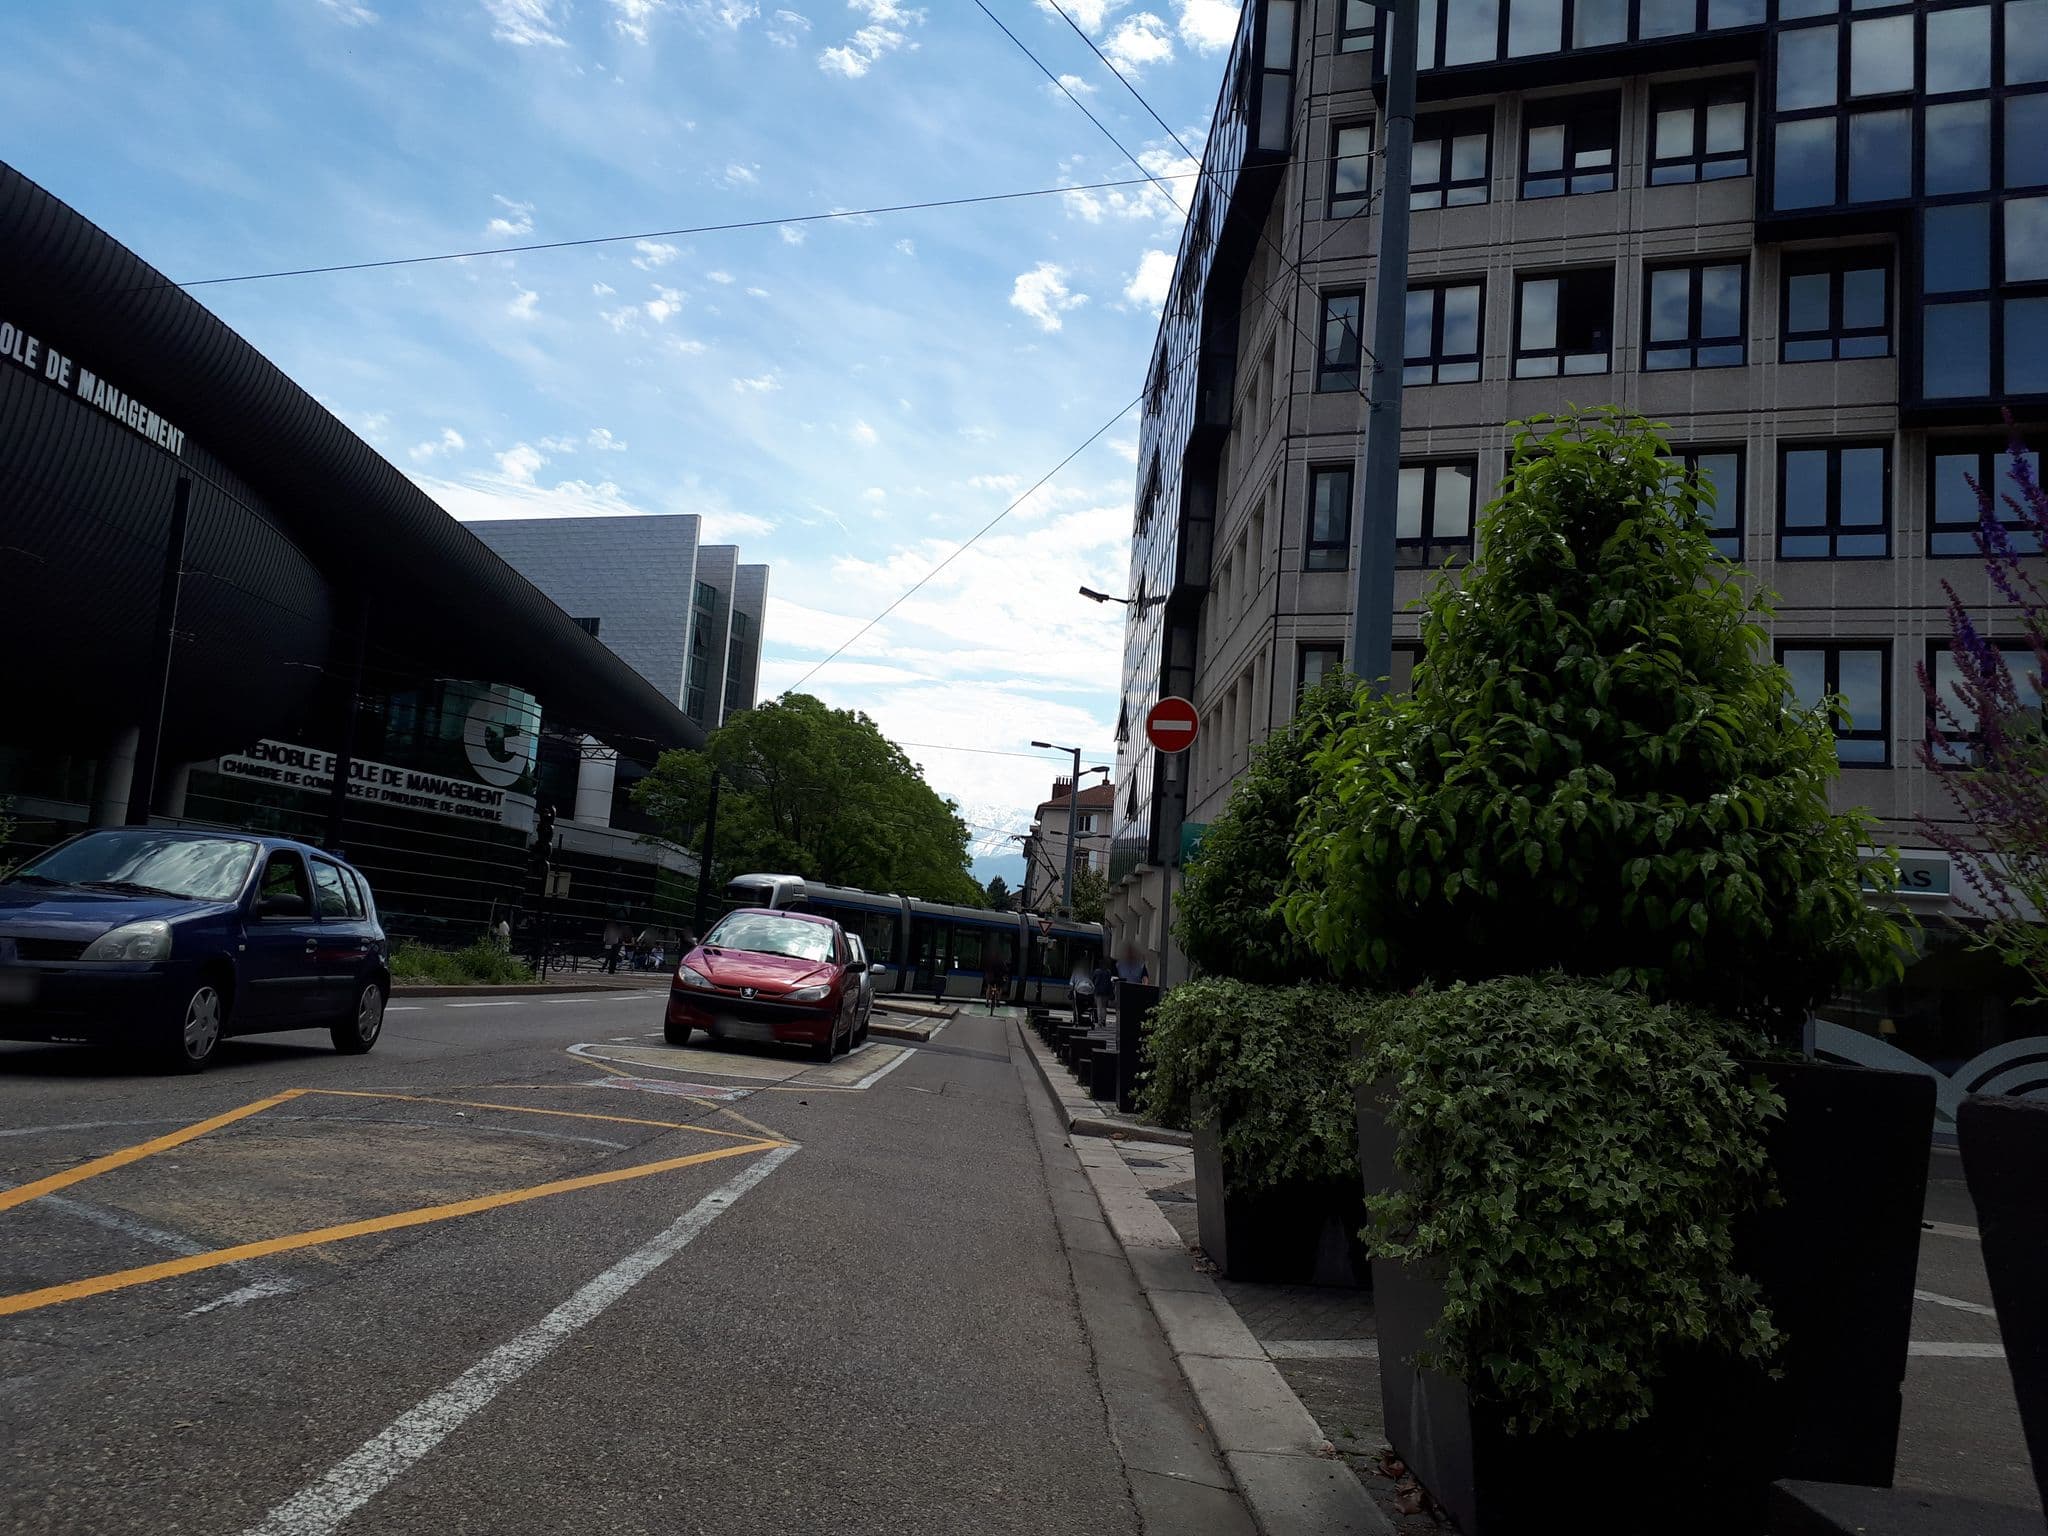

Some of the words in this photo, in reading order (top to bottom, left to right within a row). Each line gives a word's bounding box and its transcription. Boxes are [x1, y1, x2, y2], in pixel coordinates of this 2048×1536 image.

[44, 347, 73, 389] DE
[76, 367, 185, 457] MANAGEMENT
[222, 759, 283, 781] CHAMBRE
[284, 771, 302, 785] DE
[365, 786, 380, 799] ET
[439, 801, 455, 812] DE
[455, 803, 503, 822] GRENOBLE
[324, 756, 379, 782] EOLE
[381, 768, 404, 788] DE
[406, 774, 505, 807] MANAGEMENT
